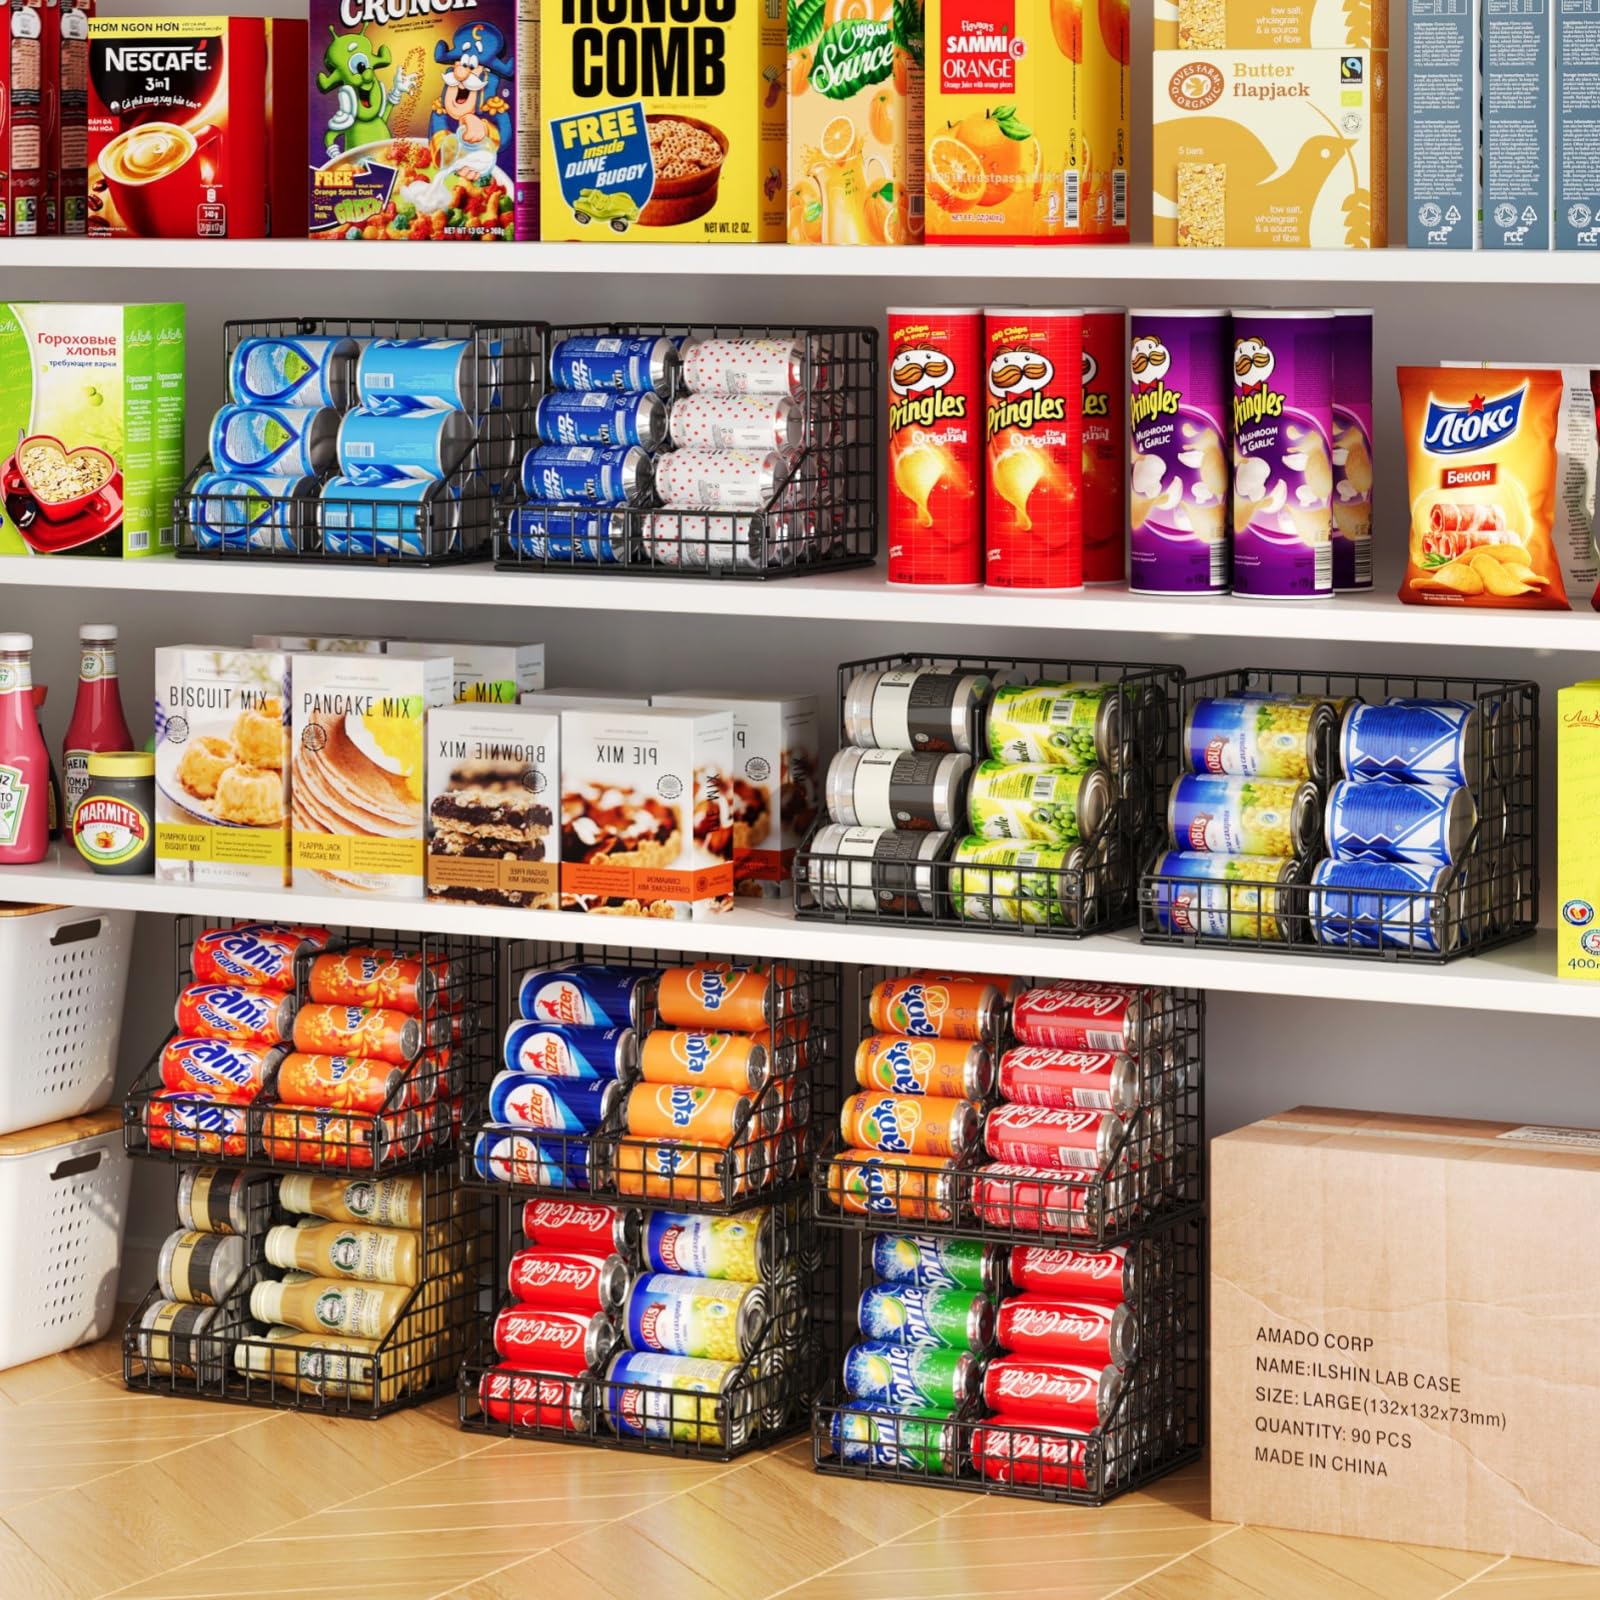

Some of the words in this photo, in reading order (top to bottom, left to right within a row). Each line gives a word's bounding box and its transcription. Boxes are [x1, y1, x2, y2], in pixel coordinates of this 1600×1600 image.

[121, 23, 153, 32] NGON
[1256, 16, 1299, 26] wholegrain
[105, 40, 208, 72] NESCAFÉ
[572, 27, 726, 98] COMB
[811, 41, 894, 93] Source
[943, 58, 1012, 78] ORANGE
[1172, 65, 1195, 93] DOVES
[1196, 64, 1220, 83] FARM
[1233, 63, 1295, 77] Butter
[1177, 87, 1222, 109] ORGANIC
[1233, 83, 1310, 101] flapjack
[560, 107, 638, 150] FREE
[583, 139, 625, 160] inside
[315, 171, 353, 187] FREE
[565, 156, 607, 179] DUNE
[596, 163, 648, 188] BUGGY
[704, 222, 718, 234] NET
[1255, 216, 1298, 225] wholegrain
[38, 333, 116, 347] Гороховые
[66, 347, 116, 356] хлопья
[889, 390, 966, 438] Pringles
[987, 392, 1065, 440] Pringles
[1131, 381, 1181, 431] Pringles
[1234, 384, 1284, 433] Pringles
[912, 431, 967, 445] Original
[1010, 433, 1066, 447] Original
[1448, 470, 1490, 484] Бекон
[170, 686, 231, 709] BISCUIT
[241, 691, 268, 710] MIX
[304, 693, 373, 716] PANCAKE
[383, 698, 410, 719] MIX
[67, 758, 88, 770] HEIN
[79, 802, 138, 829] MARMITE
[1256, 1327, 1319, 1347] AMADO
[1325, 1333, 1374, 1352] CORP
[1256, 1357, 1370, 1383] NAME:ILSHIN
[1376, 1370, 1409, 1387] LAB
[1414, 1374, 1461, 1393] CASE
[1256, 1387, 1299, 1405] SIZE:
[1303, 1391, 1507, 1431] LARGE(132x132x73mm)
[1256, 1416, 1346, 1441] QUANTITY:
[1351, 1428, 1371, 1444] 90
[1376, 1431, 1412, 1449] PCS
[1255, 1447, 1304, 1466] MADE
[1310, 1454, 1326, 1470] IN
[1331, 1456, 1387, 1477] CHINA
